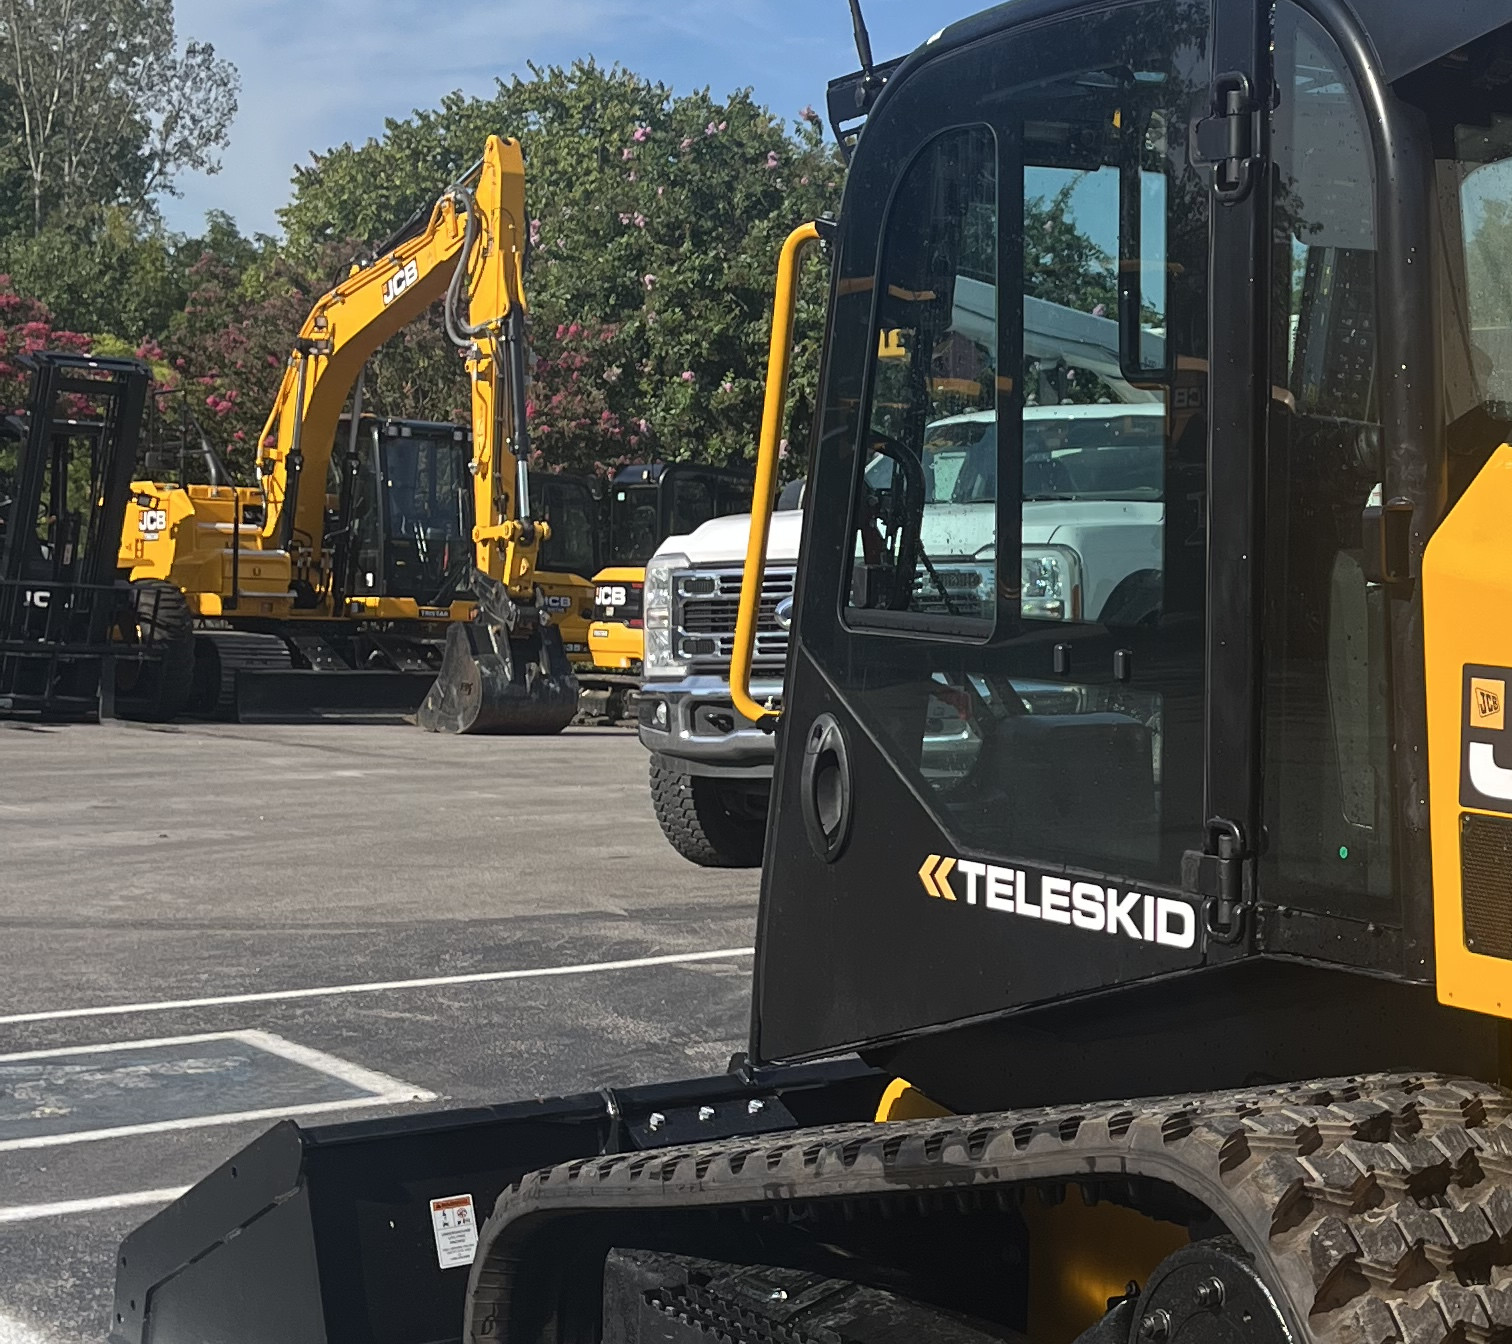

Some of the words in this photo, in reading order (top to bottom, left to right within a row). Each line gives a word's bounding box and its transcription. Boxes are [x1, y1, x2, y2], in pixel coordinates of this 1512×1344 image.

[383, 258, 419, 305] JCB
[138, 510, 167, 531] JCB
[595, 587, 627, 606] JCB
[1479, 691, 1499, 714] JCB
[957, 859, 1196, 949] TELESKID
